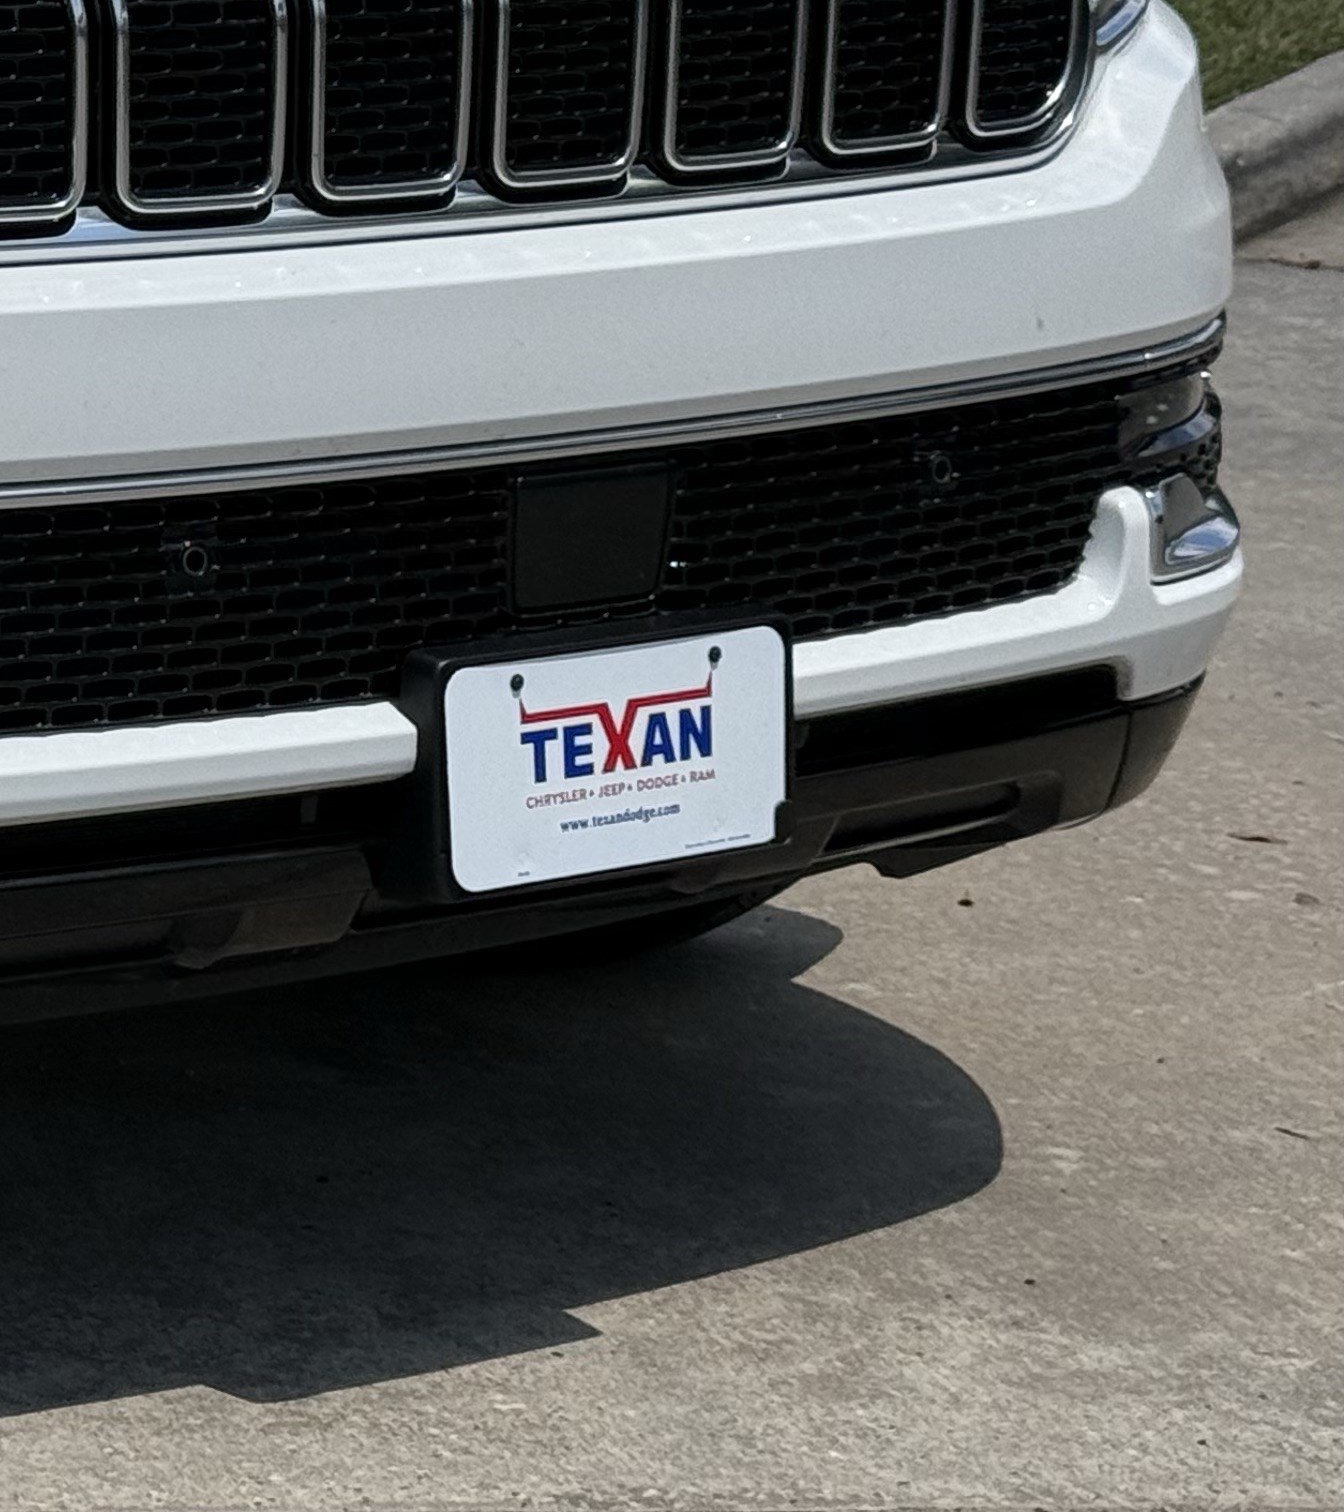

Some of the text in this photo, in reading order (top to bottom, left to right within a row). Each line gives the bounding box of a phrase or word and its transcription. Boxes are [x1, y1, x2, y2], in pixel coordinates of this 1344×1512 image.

[519, 687, 713, 784] TEXAN
[525, 768, 717, 810] CHRYSLER JEEP DODGE RAM
[559, 803, 681, 833] www.texandodge.com
